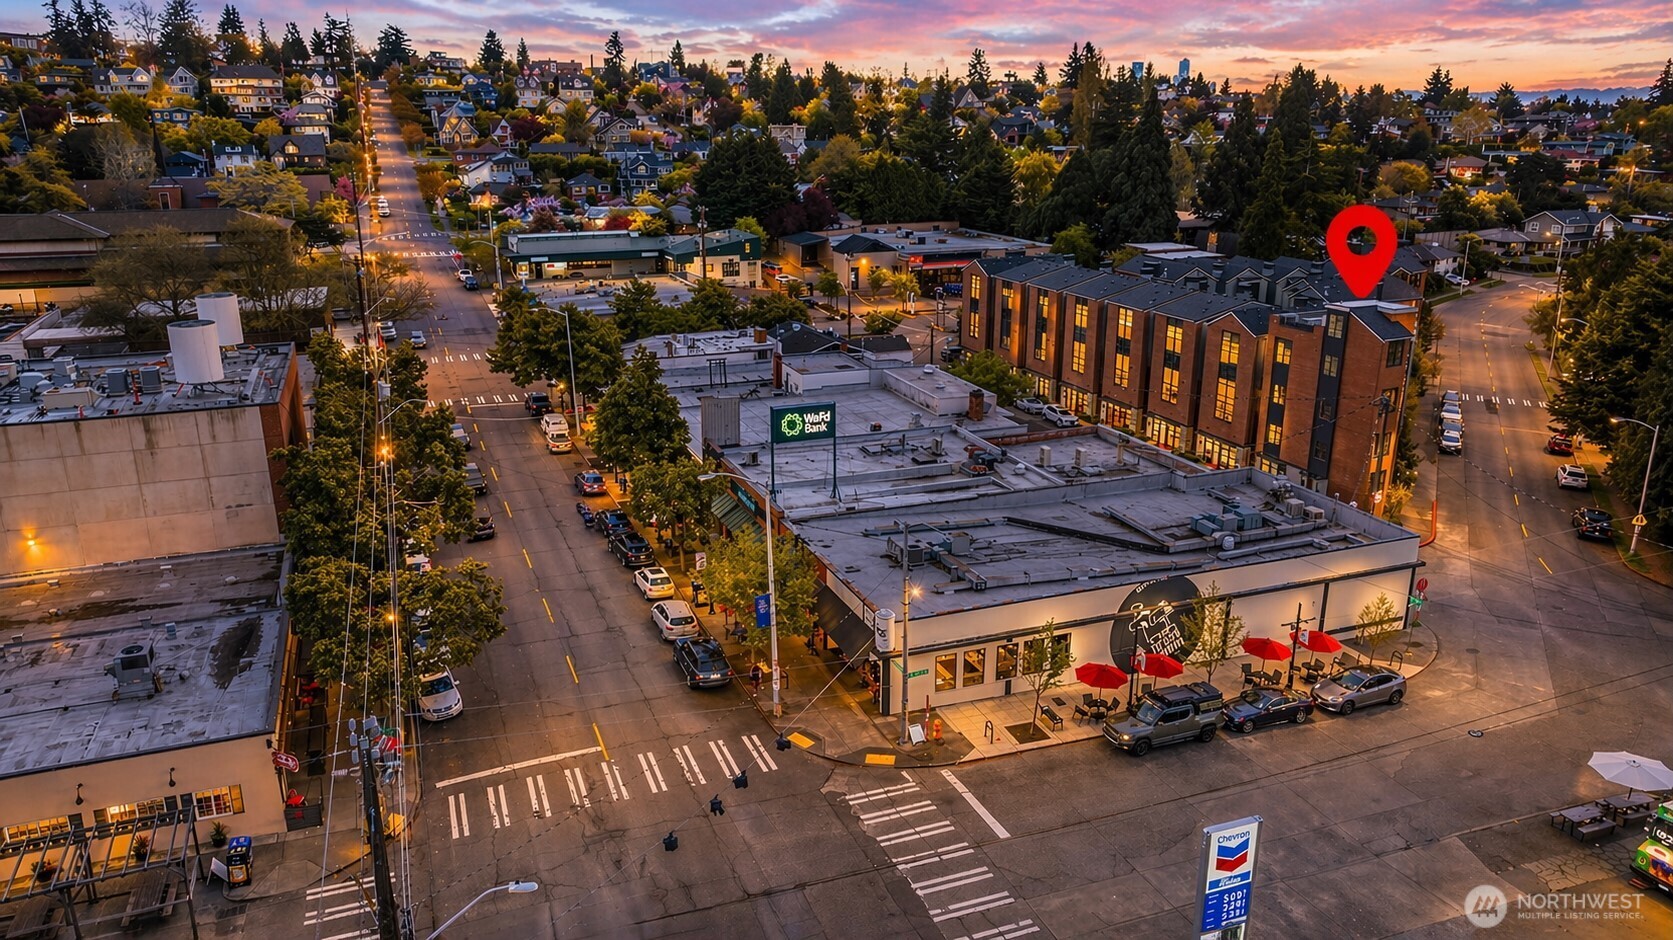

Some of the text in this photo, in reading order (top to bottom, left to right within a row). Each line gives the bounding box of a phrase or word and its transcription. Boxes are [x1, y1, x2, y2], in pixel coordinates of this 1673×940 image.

[803, 411, 831, 423] WaFd
[804, 422, 828, 434] Bank
[1217, 830, 1251, 844] Chevron
